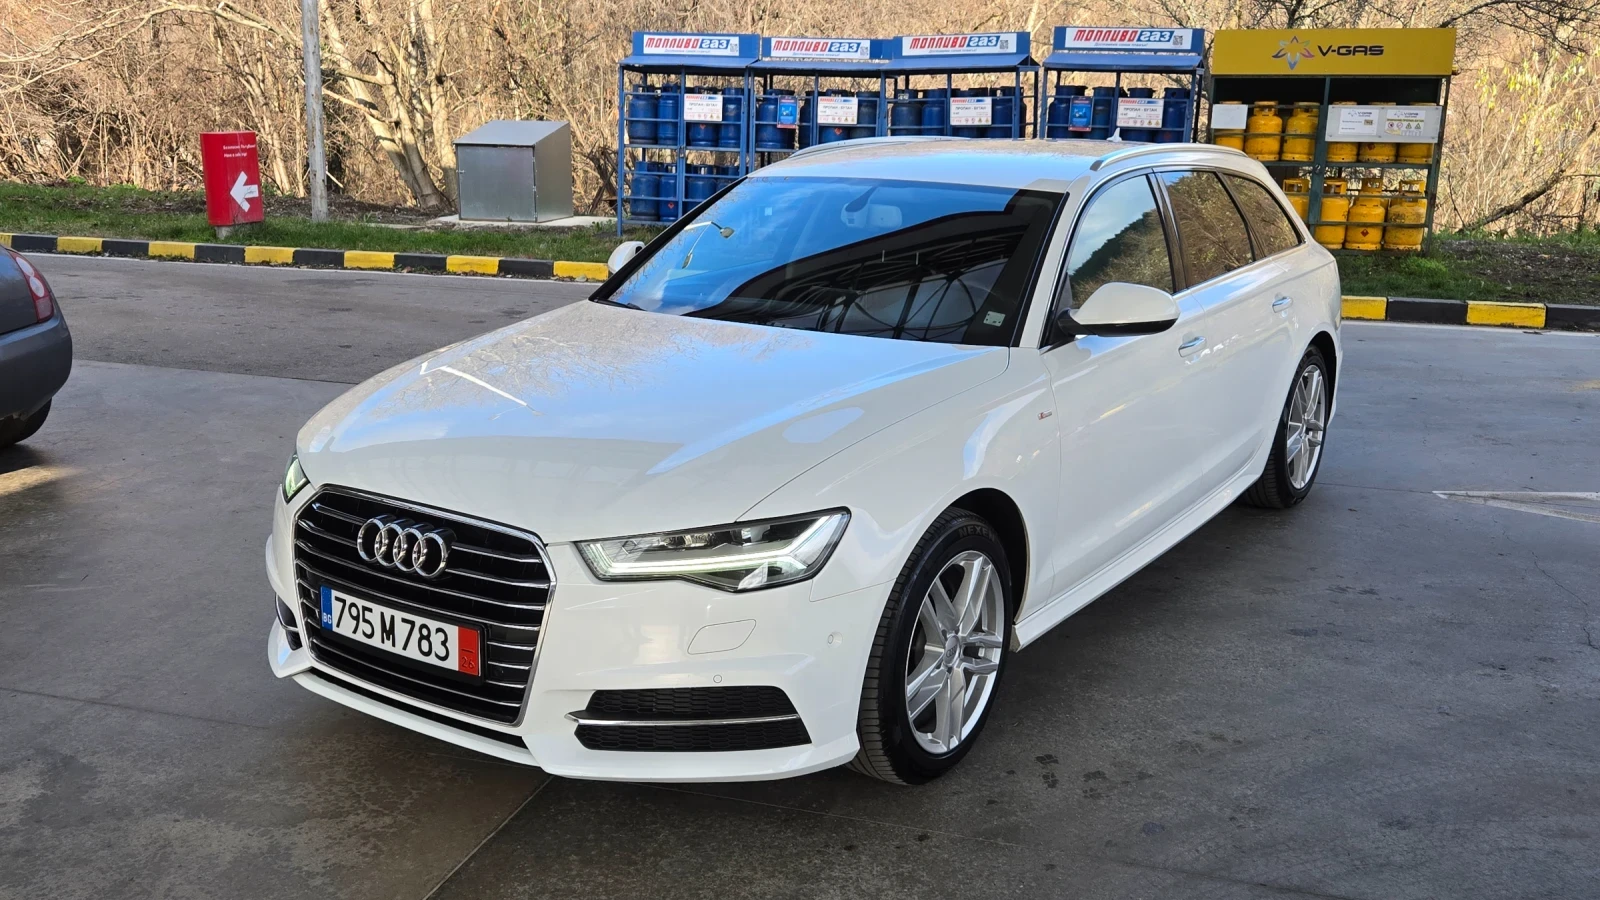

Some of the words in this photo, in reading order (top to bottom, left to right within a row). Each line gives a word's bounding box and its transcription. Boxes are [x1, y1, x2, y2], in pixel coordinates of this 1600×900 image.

[1317, 45, 1385, 57] V-GAS
[958, 525, 995, 542] NEXEN
[322, 614, 332, 624] BG
[334, 595, 375, 640] 795
[380, 611, 396, 648] M
[400, 617, 450, 662] 783
[461, 656, 475, 670] 26
